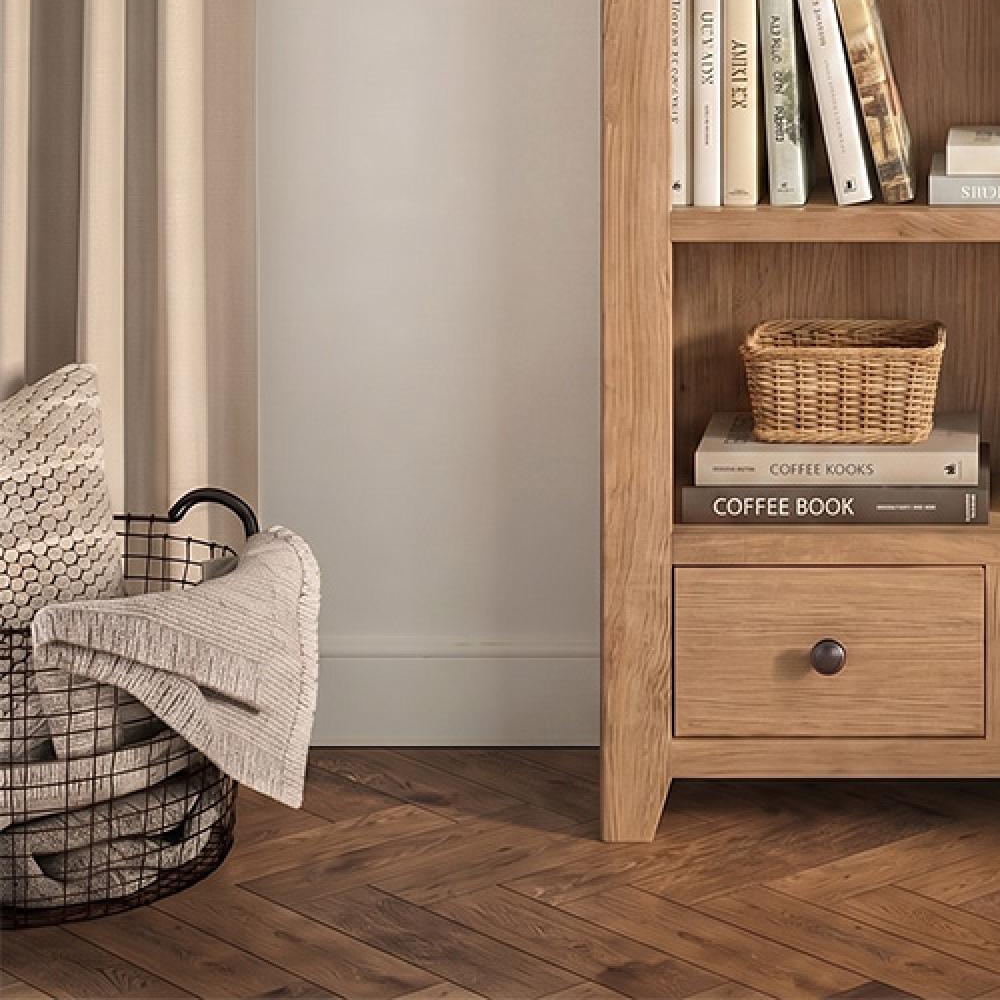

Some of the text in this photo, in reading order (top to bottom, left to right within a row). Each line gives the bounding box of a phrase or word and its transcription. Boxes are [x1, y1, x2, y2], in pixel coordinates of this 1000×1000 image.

[769, 463, 821, 476] COFFEE
[825, 463, 875, 476] KOOKS
[713, 497, 855, 516] COFFEE BOOK
